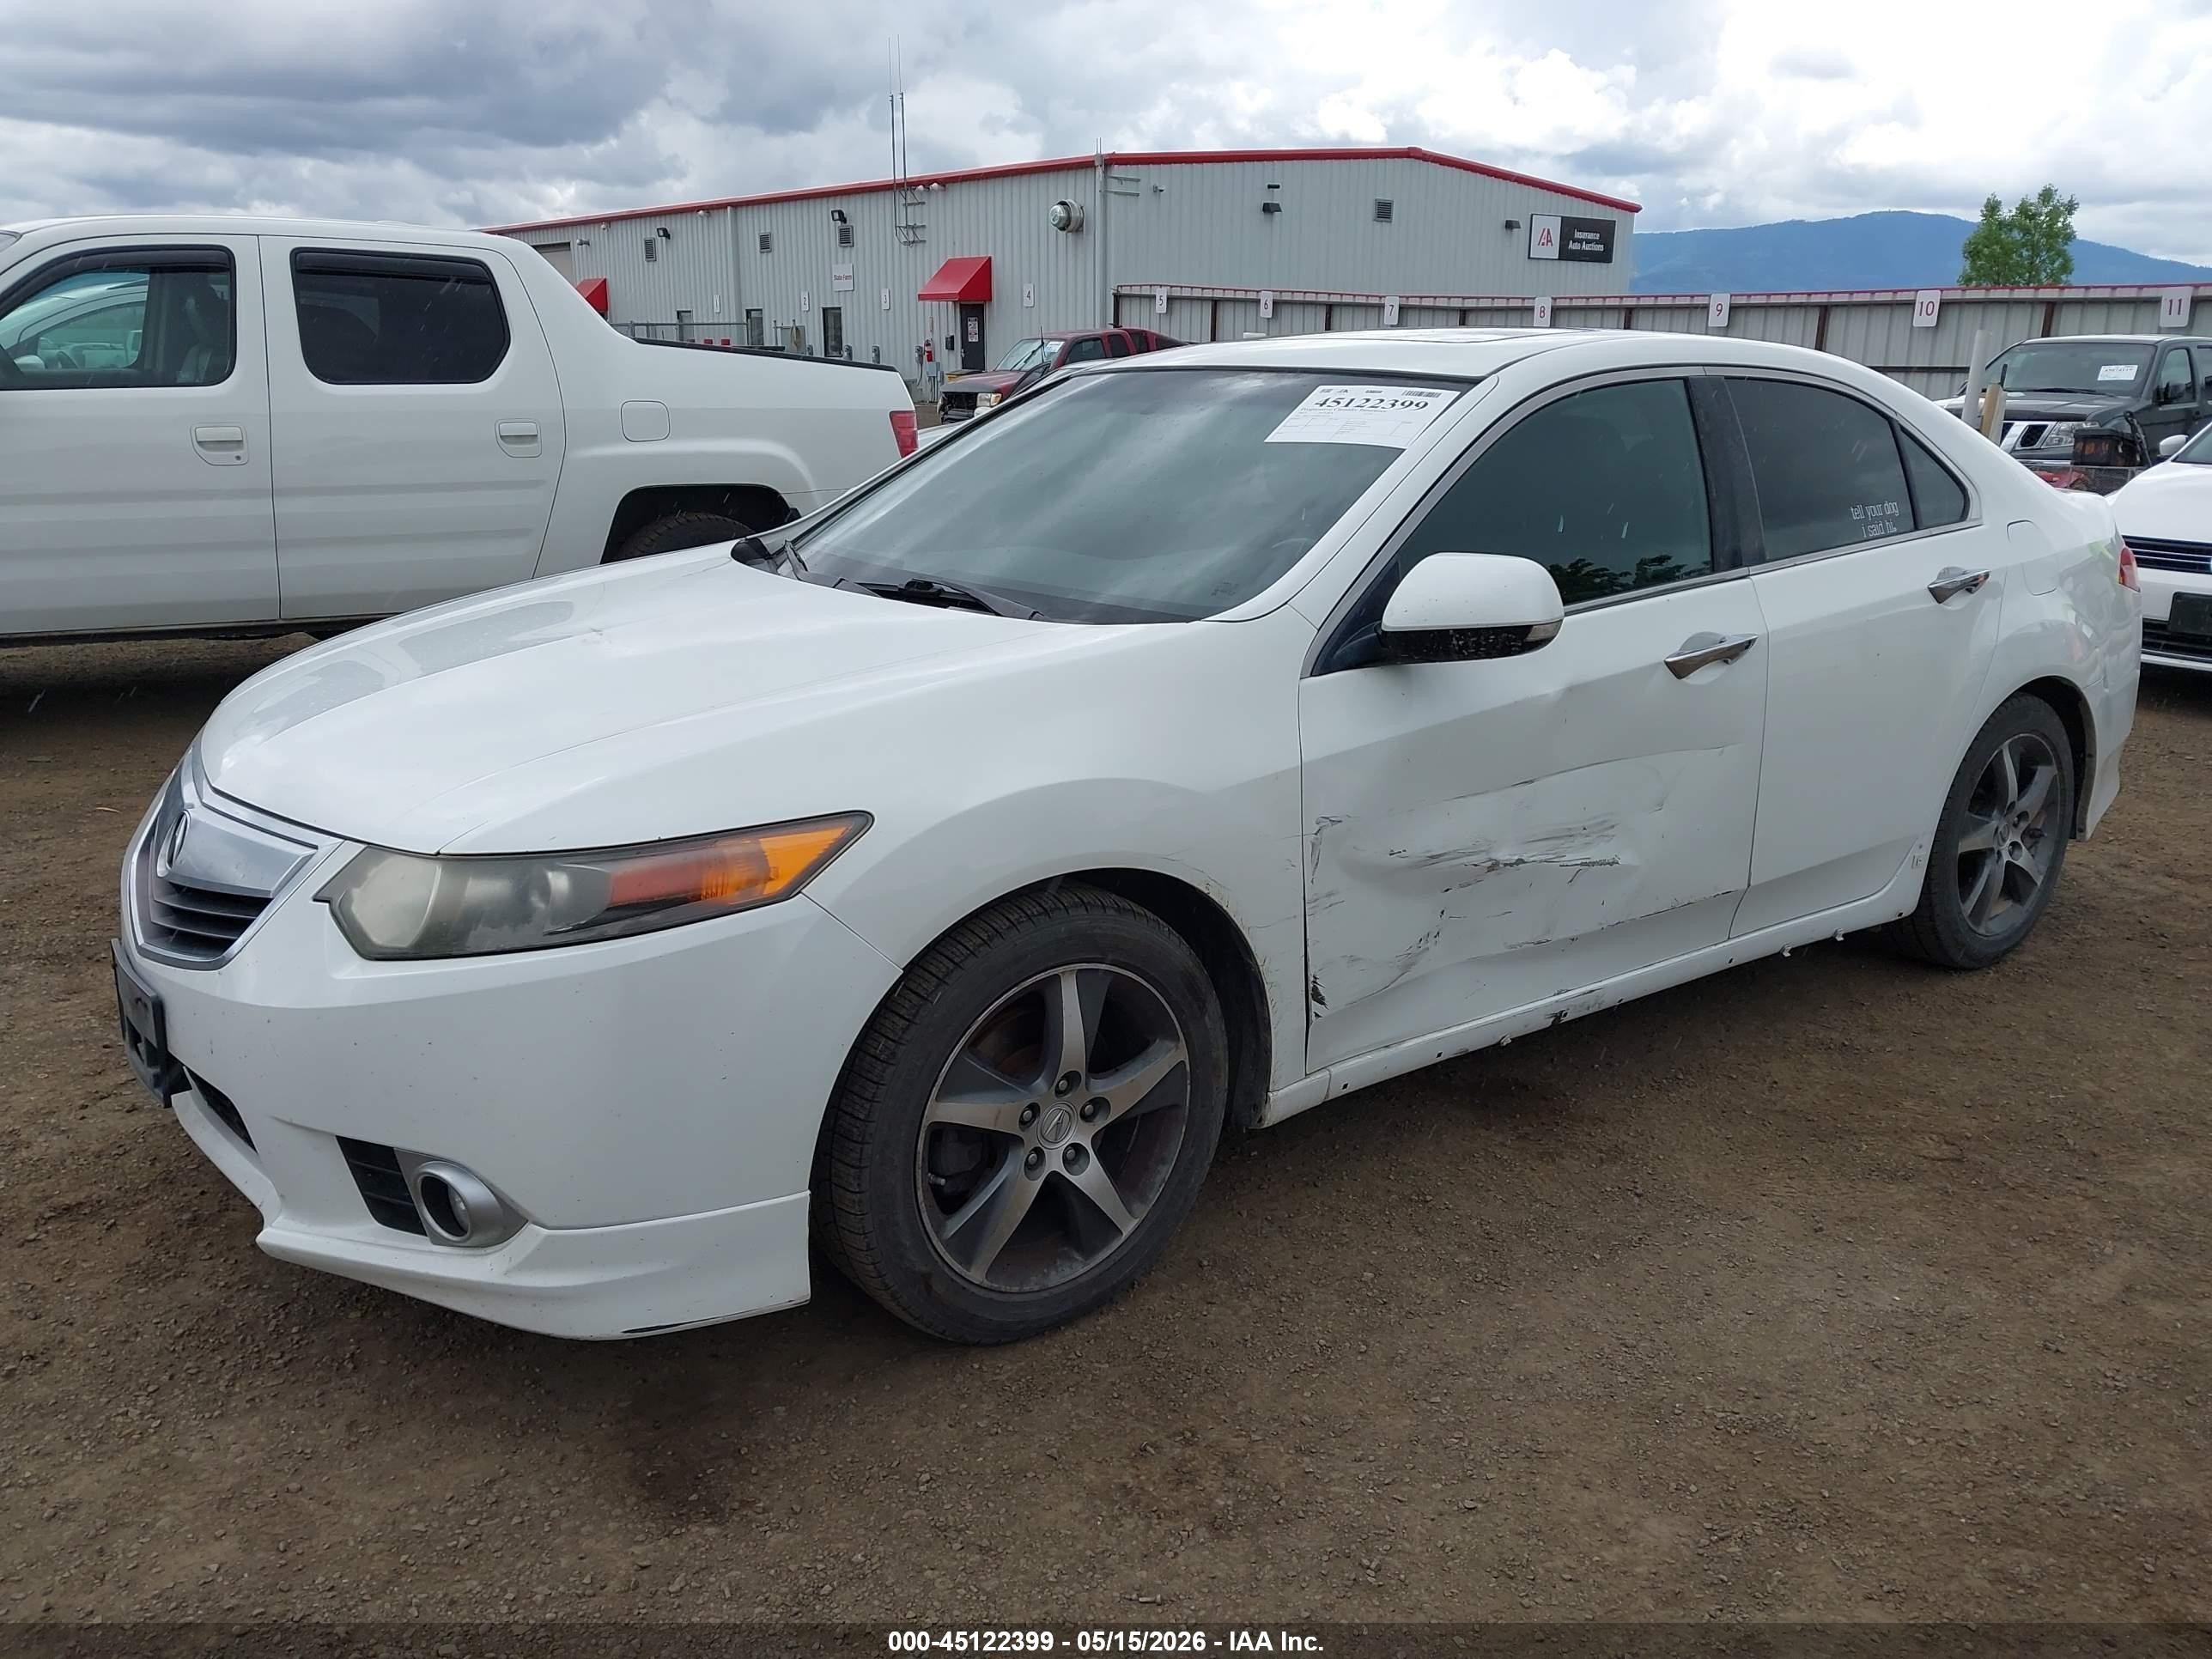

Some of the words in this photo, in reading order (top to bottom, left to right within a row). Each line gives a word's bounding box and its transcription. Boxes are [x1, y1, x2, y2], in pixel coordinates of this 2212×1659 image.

[1574, 228, 1601, 240] Insurance
[1568, 240, 1581, 250] Auto
[1582, 240, 1604, 252] Auctions
[1026, 290, 1031, 301] 4
[1159, 295, 1164, 307] 5
[1263, 298, 1269, 310] 6
[1389, 304, 1395, 317] 7
[1716, 303, 1723, 317] 9
[1918, 301, 1935, 317] 10
[2168, 298, 2182, 316] 11
[1539, 305, 1546, 319] 8
[1315, 397, 1429, 411] 45122399
[1850, 505, 1865, 520] tell
[1865, 504, 1883, 520] your
[1884, 501, 1899, 516] dog
[1862, 523, 1867, 538] i
[1868, 521, 1884, 537] said
